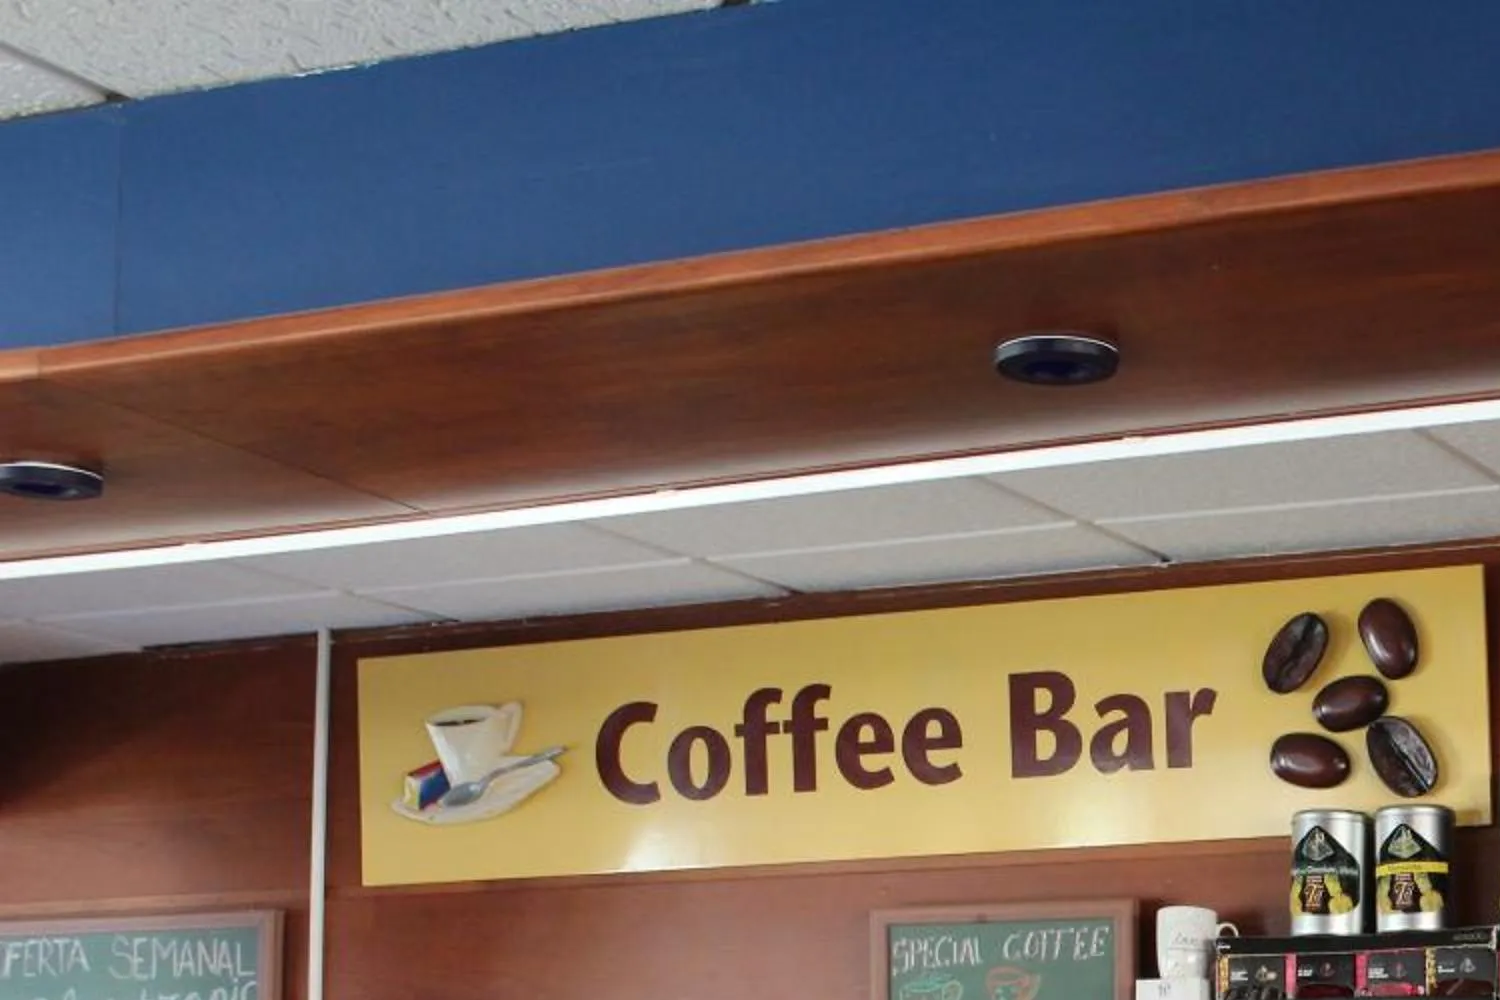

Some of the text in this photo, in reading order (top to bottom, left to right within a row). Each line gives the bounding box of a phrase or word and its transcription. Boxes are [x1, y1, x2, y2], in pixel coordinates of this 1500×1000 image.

[597, 670, 1217, 804] Coffee Bar
[0, 935, 256, 980] FERTA SEMANAL
[892, 936, 983, 976] SPECIAL
